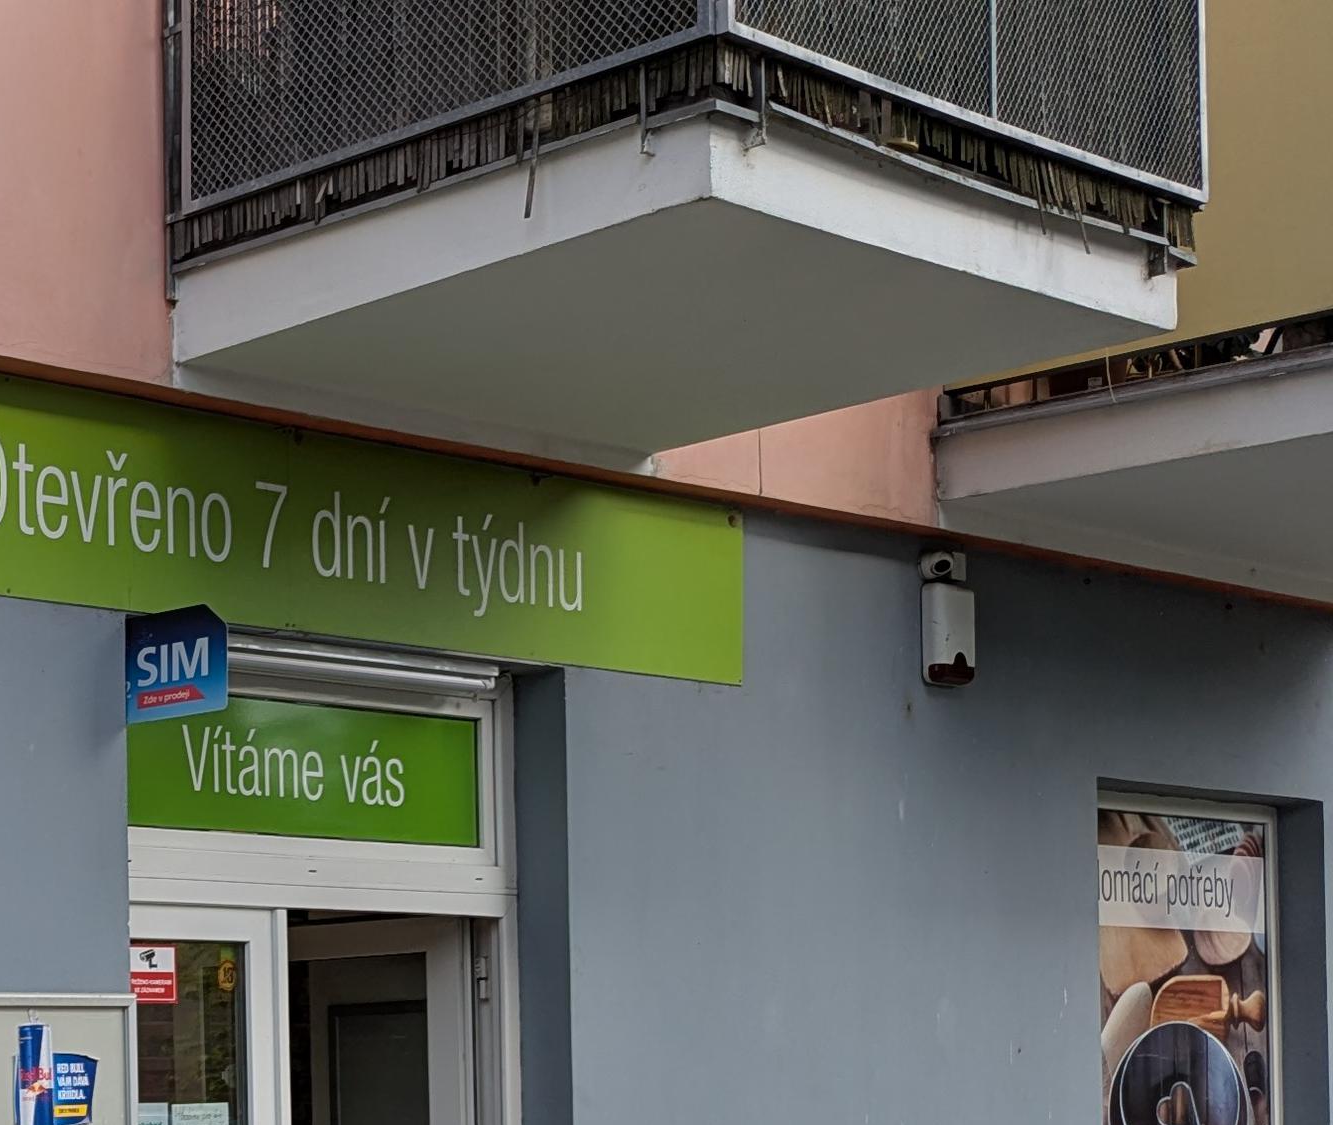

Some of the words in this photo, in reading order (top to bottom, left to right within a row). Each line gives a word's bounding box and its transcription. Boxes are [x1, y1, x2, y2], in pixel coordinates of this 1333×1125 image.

[255, 480, 288, 569] 7
[312, 491, 391, 585] dní
[407, 527, 434, 590] v
[452, 513, 583, 617] týdnu
[136, 636, 209, 688] SIM
[181, 724, 324, 802] Vítáme
[340, 739, 406, 808] vás
[1098, 860, 1159, 905] omácí
[1166, 865, 1235, 918] potřeby
